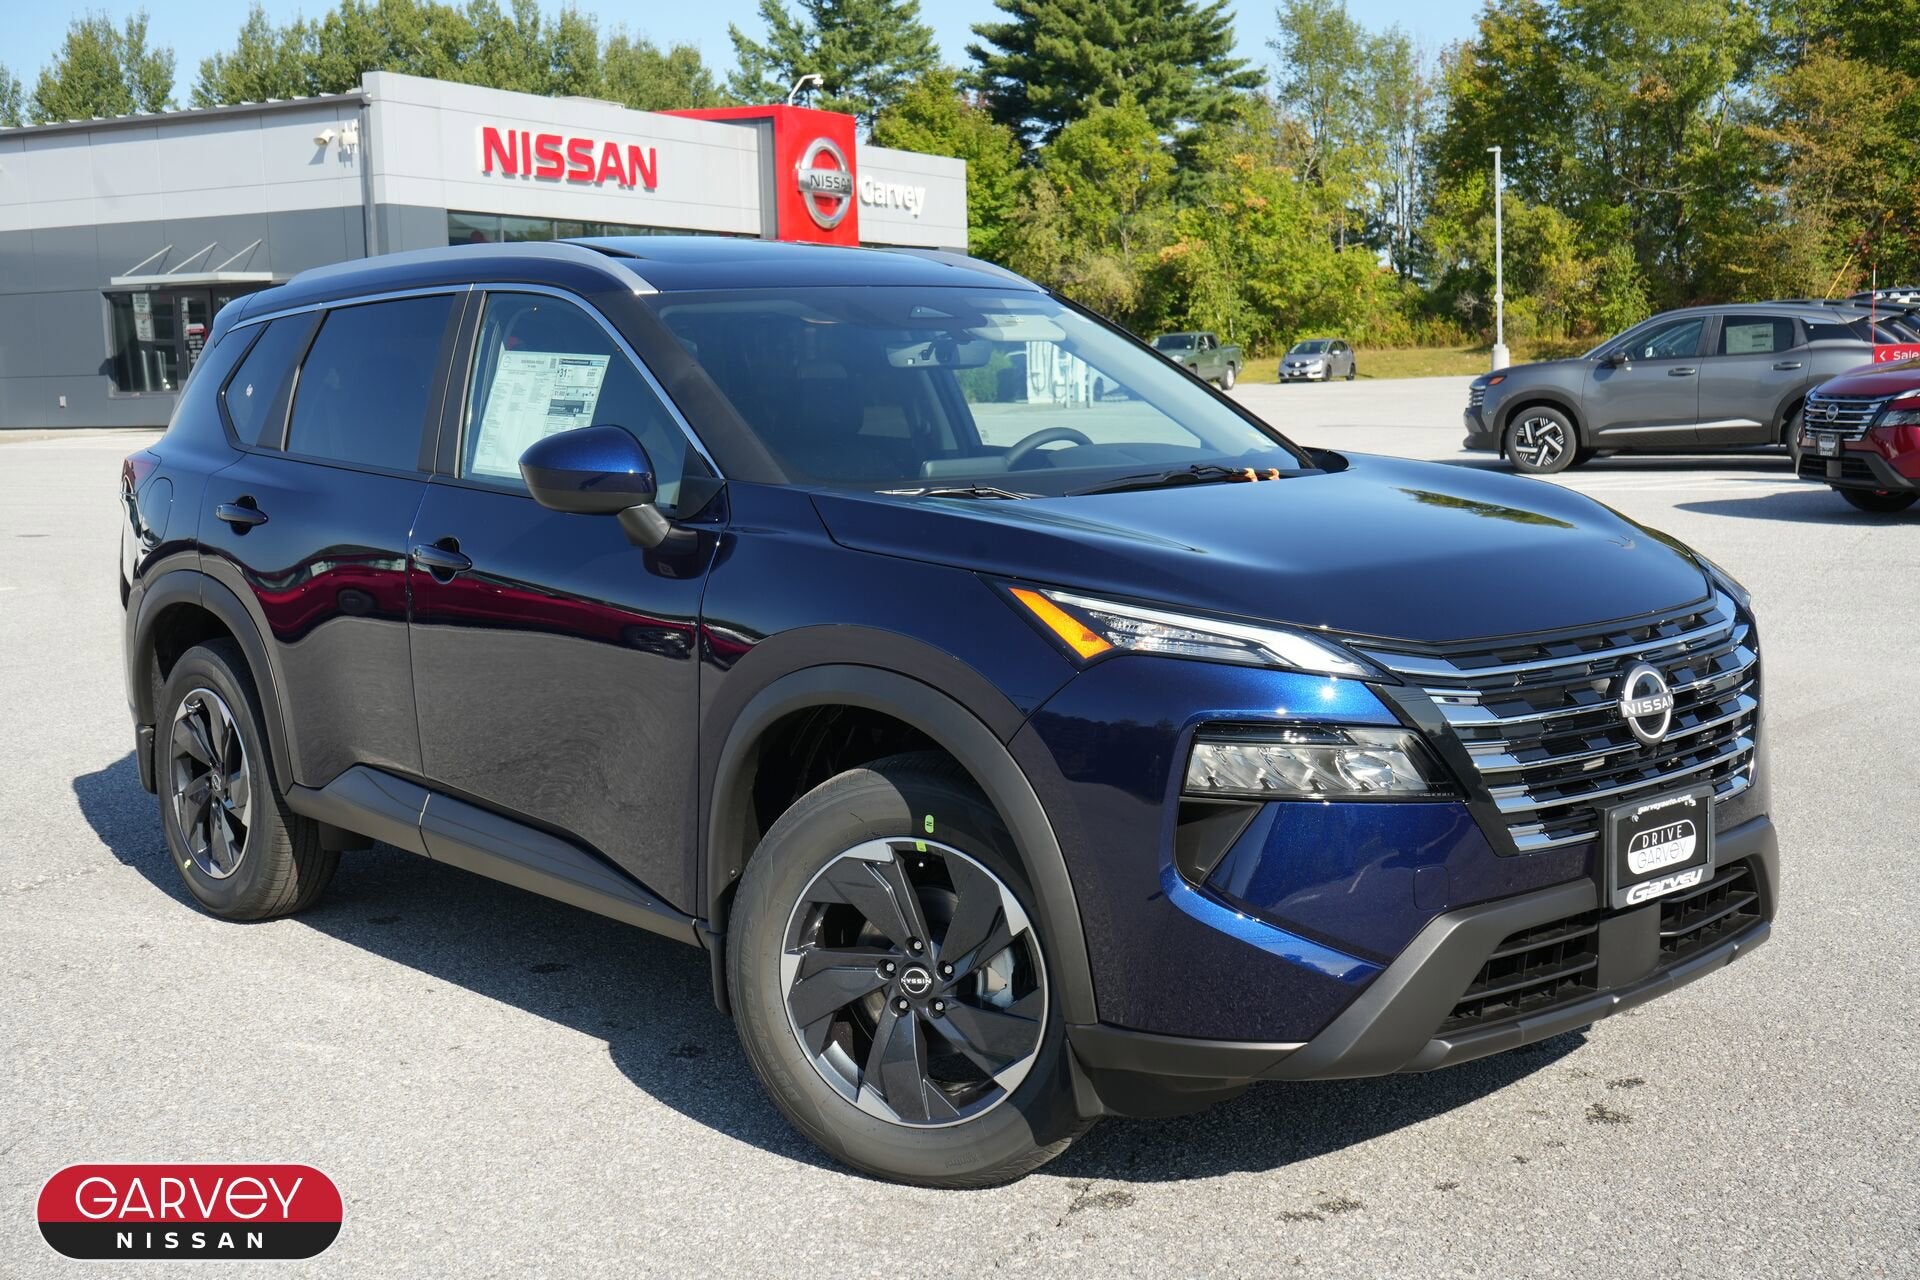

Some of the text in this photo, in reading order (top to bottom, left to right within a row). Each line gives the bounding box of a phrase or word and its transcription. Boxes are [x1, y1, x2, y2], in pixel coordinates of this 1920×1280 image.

[482, 126, 658, 189] NISSAN
[860, 176, 926, 216] Garvey
[1893, 350, 1919, 361] Sale
[1623, 694, 1674, 716] NISSAN
[1642, 825, 1683, 848] DRIVE
